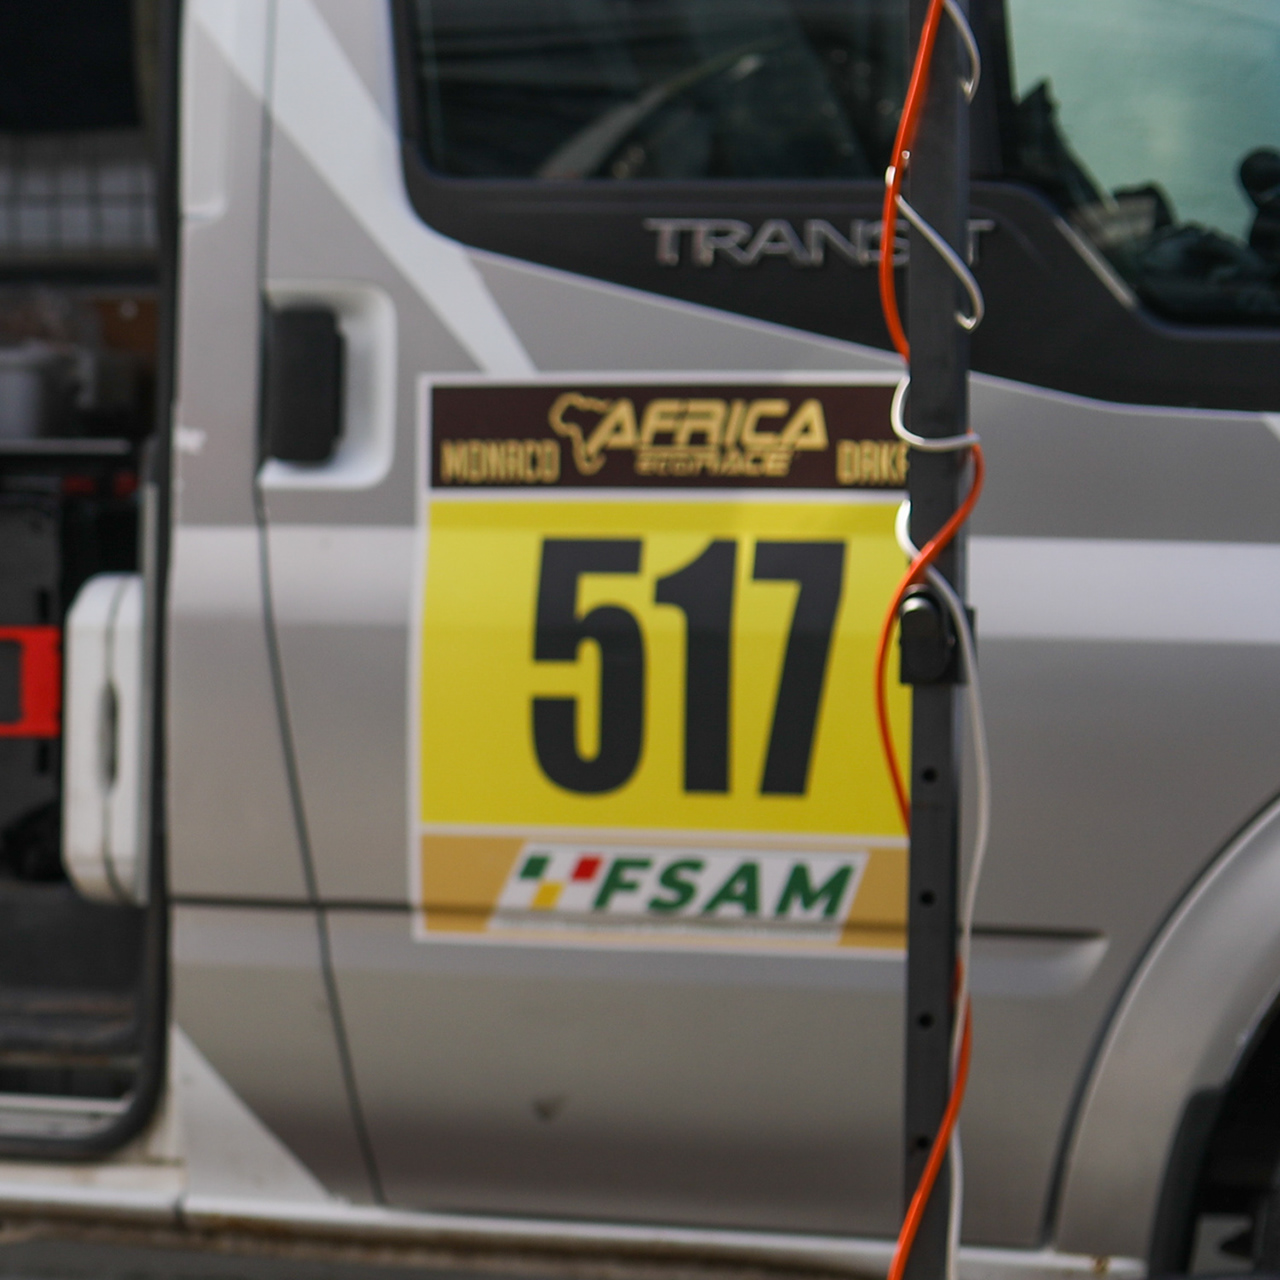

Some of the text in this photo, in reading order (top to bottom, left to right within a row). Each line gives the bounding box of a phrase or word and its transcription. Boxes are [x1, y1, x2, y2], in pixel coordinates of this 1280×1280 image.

[644, 217, 994, 267] TRANST
[586, 398, 829, 453] AFRICA
[441, 438, 561, 484] MONACO
[530, 537, 847, 797] 517
[592, 856, 853, 919] FSAM
